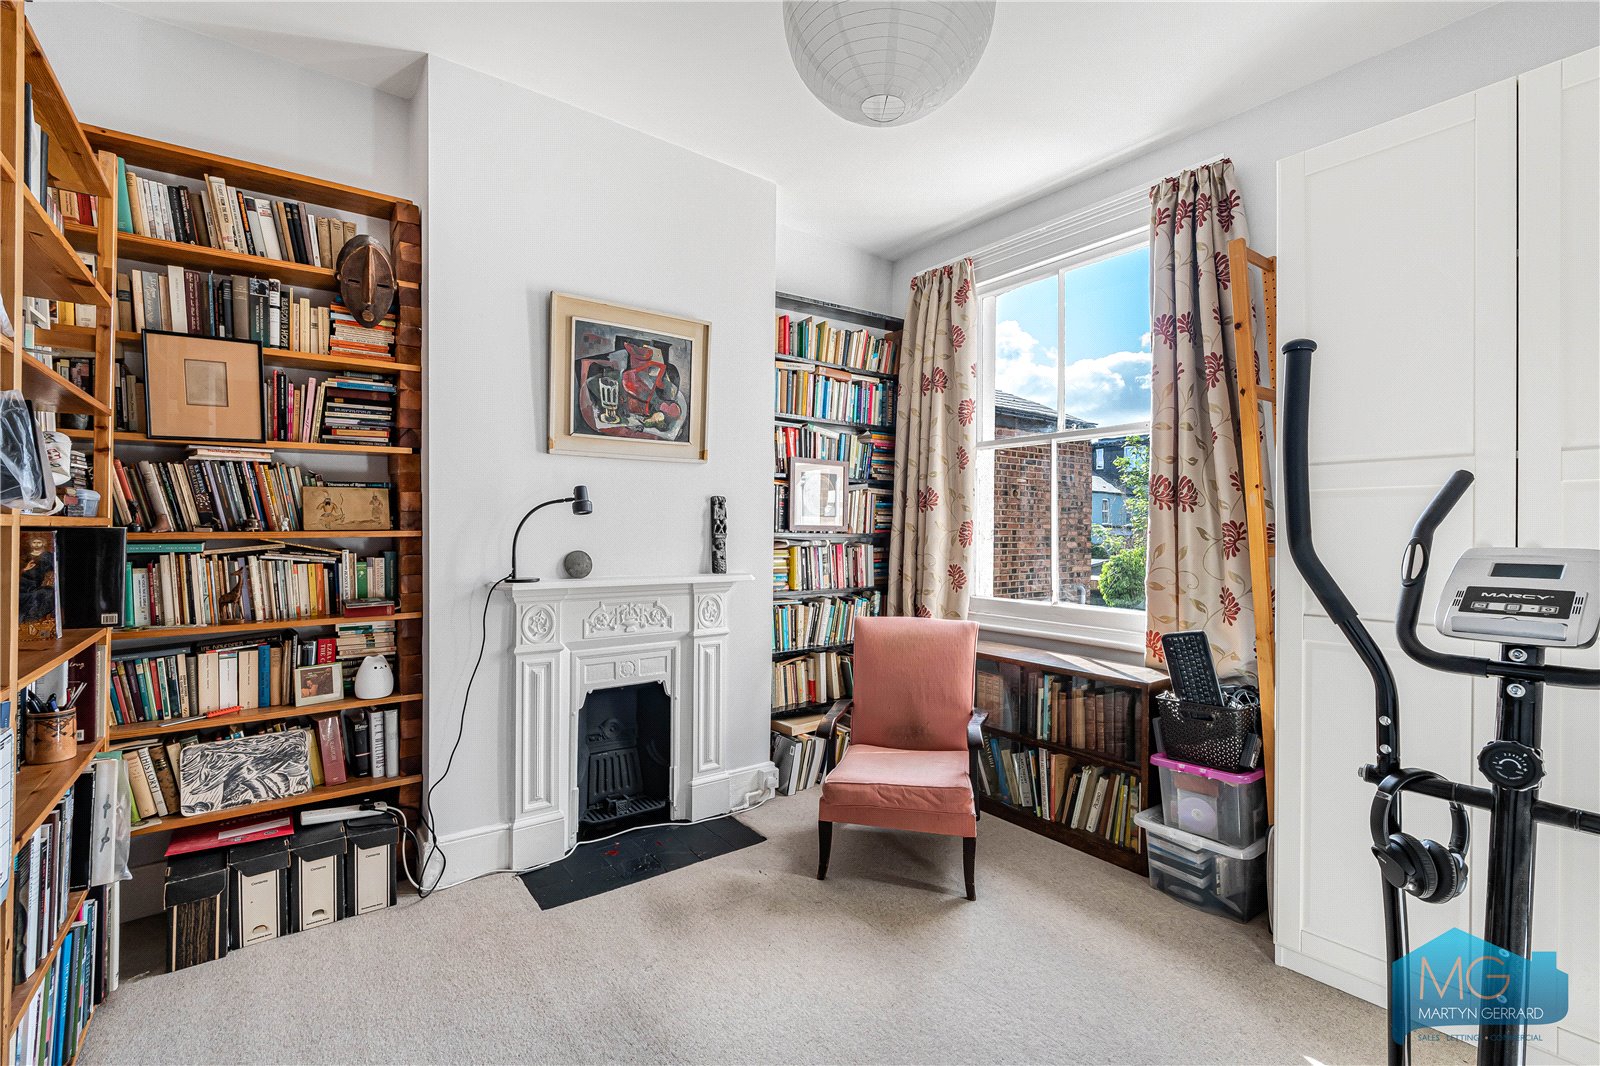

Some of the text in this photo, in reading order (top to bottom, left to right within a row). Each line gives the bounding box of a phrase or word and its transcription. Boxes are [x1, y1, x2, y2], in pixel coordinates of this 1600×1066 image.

[1481, 592, 1550, 601] MARCY
[375, 739, 384, 769] WILLIAMS
[142, 758, 158, 790] HISTORY
